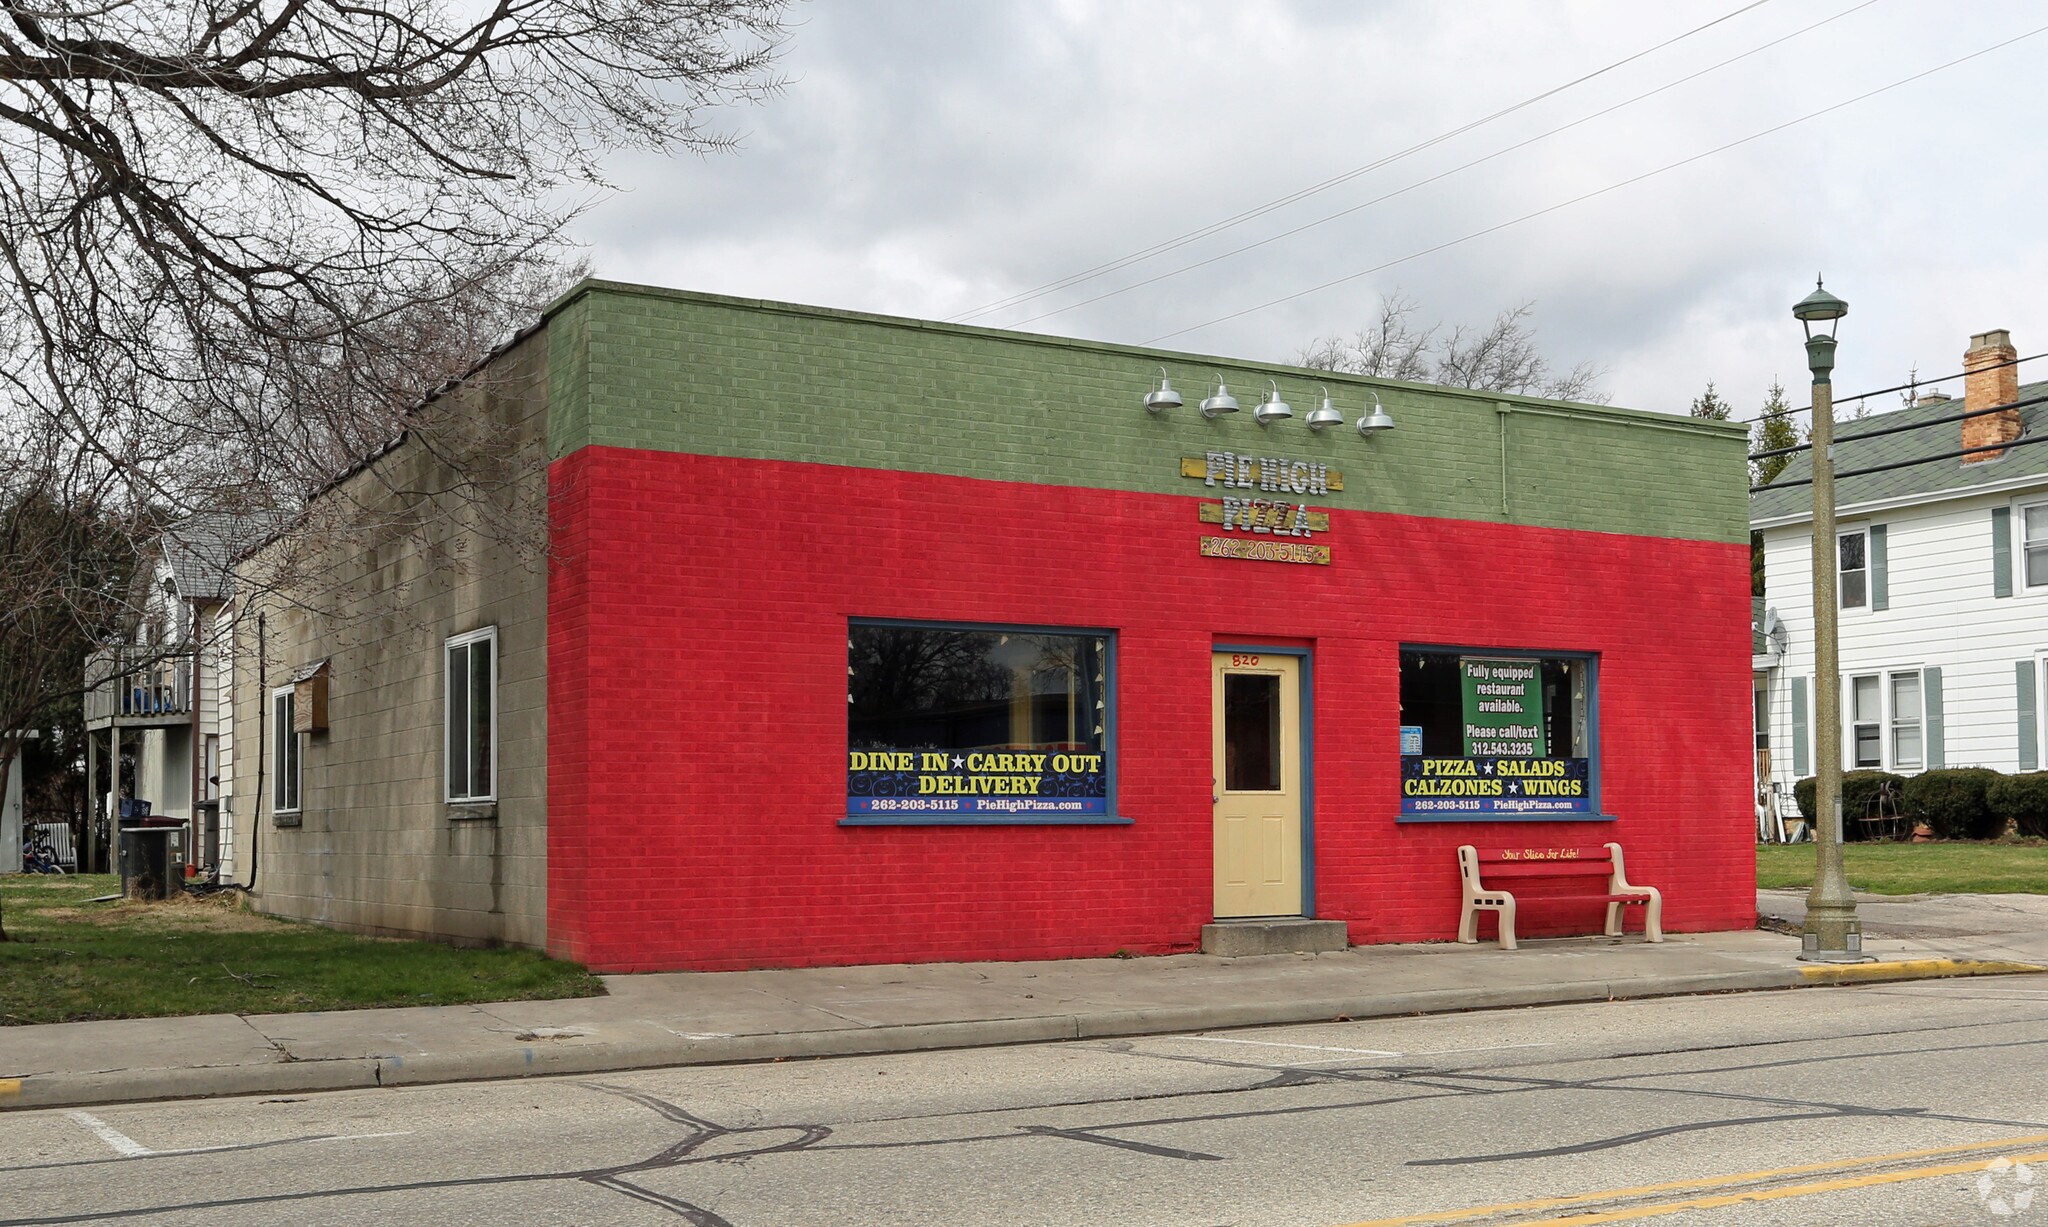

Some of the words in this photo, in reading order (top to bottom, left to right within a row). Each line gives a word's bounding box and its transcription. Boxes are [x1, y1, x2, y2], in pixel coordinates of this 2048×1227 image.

[1205, 451, 1253, 488] PIE
[1259, 457, 1328, 496] HIGH
[1222, 496, 1312, 538] PIZZA
[1211, 537, 1316, 563] 262-203-5115
[1232, 654, 1259, 667] 820
[1467, 663, 1490, 680] Fully
[1492, 665, 1534, 682] equipped
[1476, 682, 1525, 696] restaurant
[1478, 699, 1523, 713] available.
[1466, 724, 1496, 738] Please
[1499, 725, 1539, 739] call/text
[1472, 741, 1533, 755] 312.543.3235
[850, 752, 914, 771] DINE
[921, 752, 949, 772] IN
[966, 753, 1046, 772] CARRY
[1052, 754, 1101, 773] OUT
[1422, 759, 1477, 776] PIZZA
[1497, 760, 1565, 776] SALADS
[918, 775, 1042, 794] DELIVERY
[1404, 779, 1503, 795] CALZONES
[1522, 779, 1582, 796] WINGS
[871, 799, 959, 811] 262-203-5115
[976, 799, 1082, 812] PieHighPizza.com
[1415, 800, 1480, 810] 262-203-5115
[1493, 800, 1573, 811] PieHighPizza.com
[1501, 849, 1520, 860] Your
[1523, 848, 1545, 860] Slice
[1546, 848, 1559, 860] for
